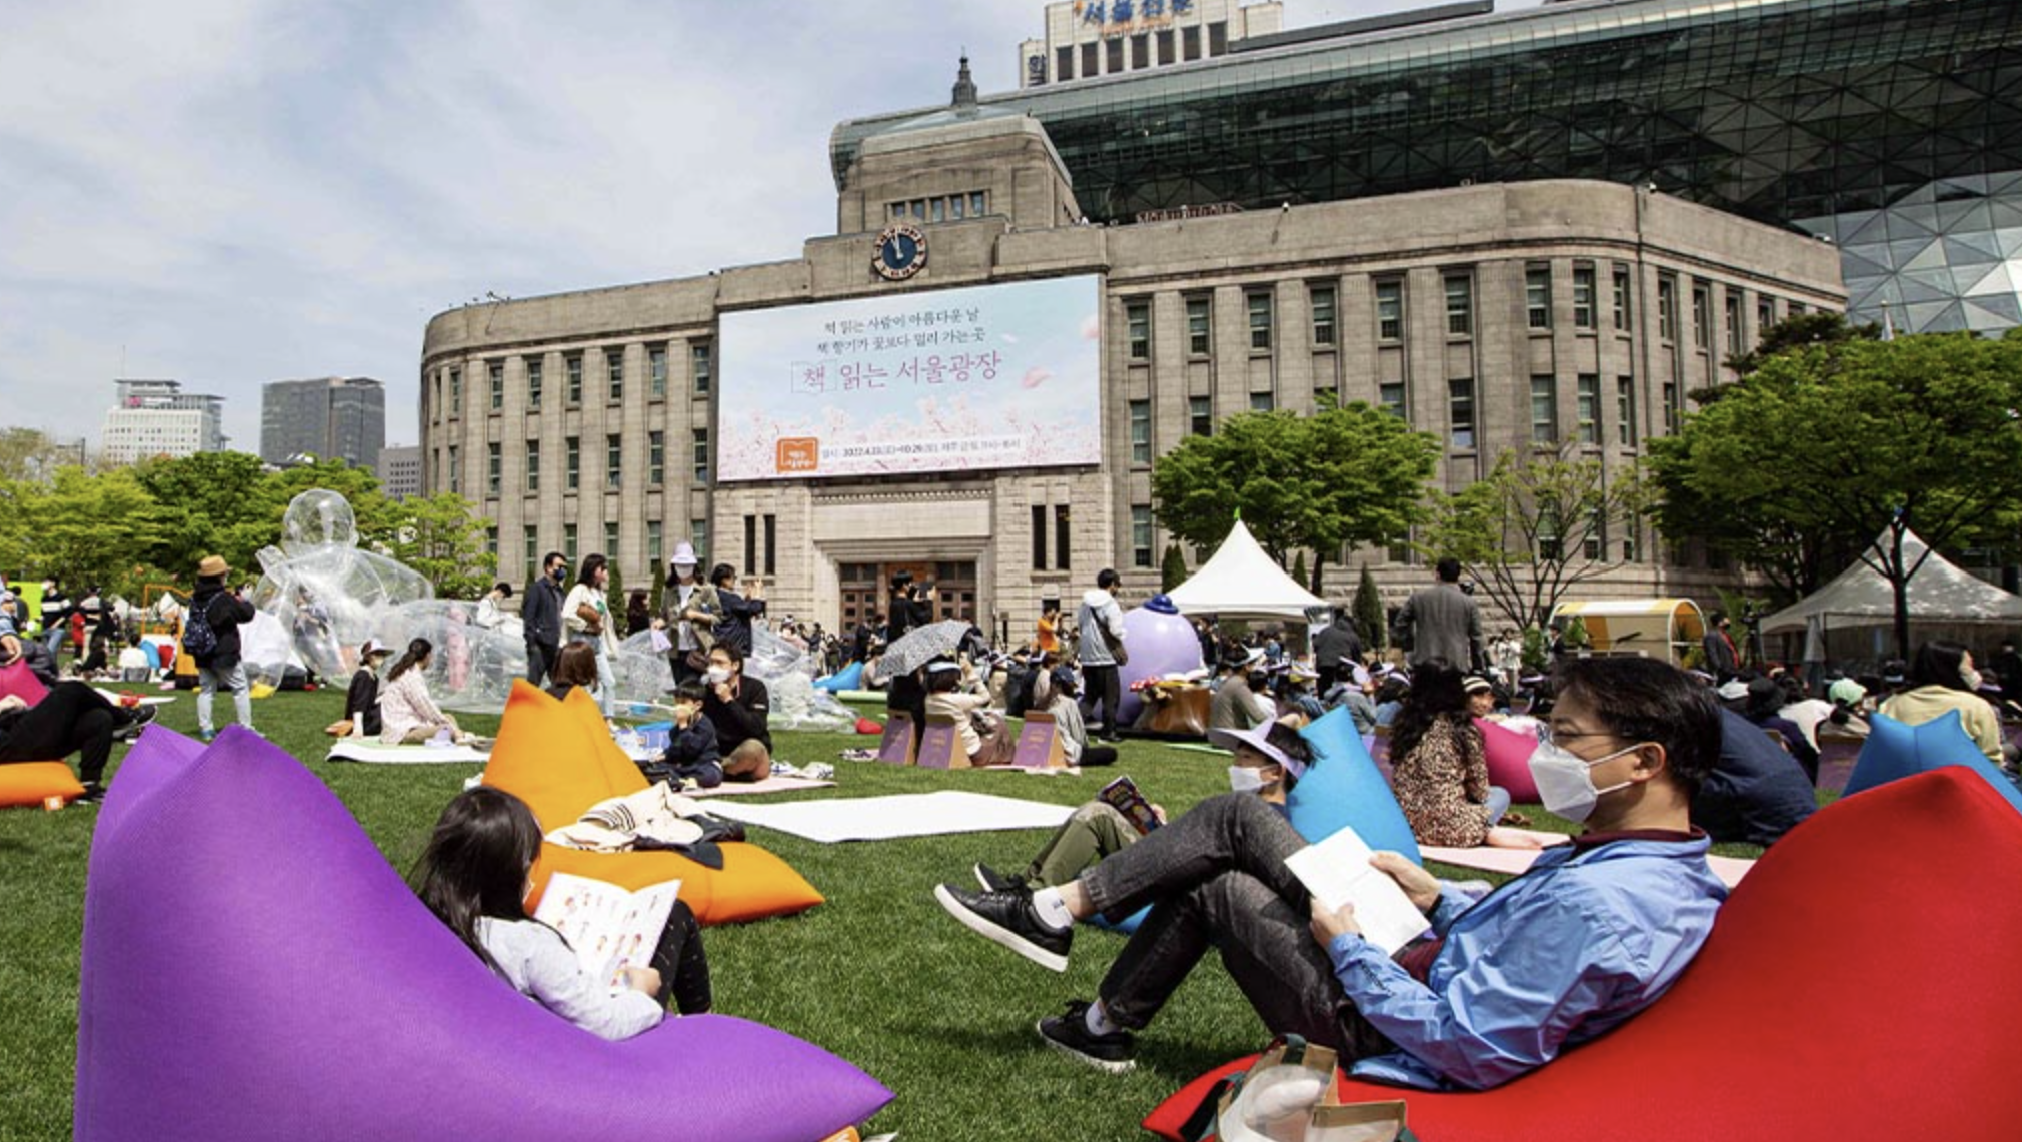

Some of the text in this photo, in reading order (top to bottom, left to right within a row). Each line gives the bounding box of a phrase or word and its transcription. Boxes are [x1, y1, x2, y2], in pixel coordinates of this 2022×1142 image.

[840, 319, 865, 335] 읽는
[868, 315, 906, 331] 사람이
[909, 309, 963, 327] 아름다운
[966, 307, 979, 322] 날
[833, 337, 869, 354] 향기가
[873, 334, 911, 350] 꽃보다
[914, 331, 938, 347] 멀리
[942, 329, 969, 344] 가는
[803, 350, 1002, 393] 책 읽는 서울광장
